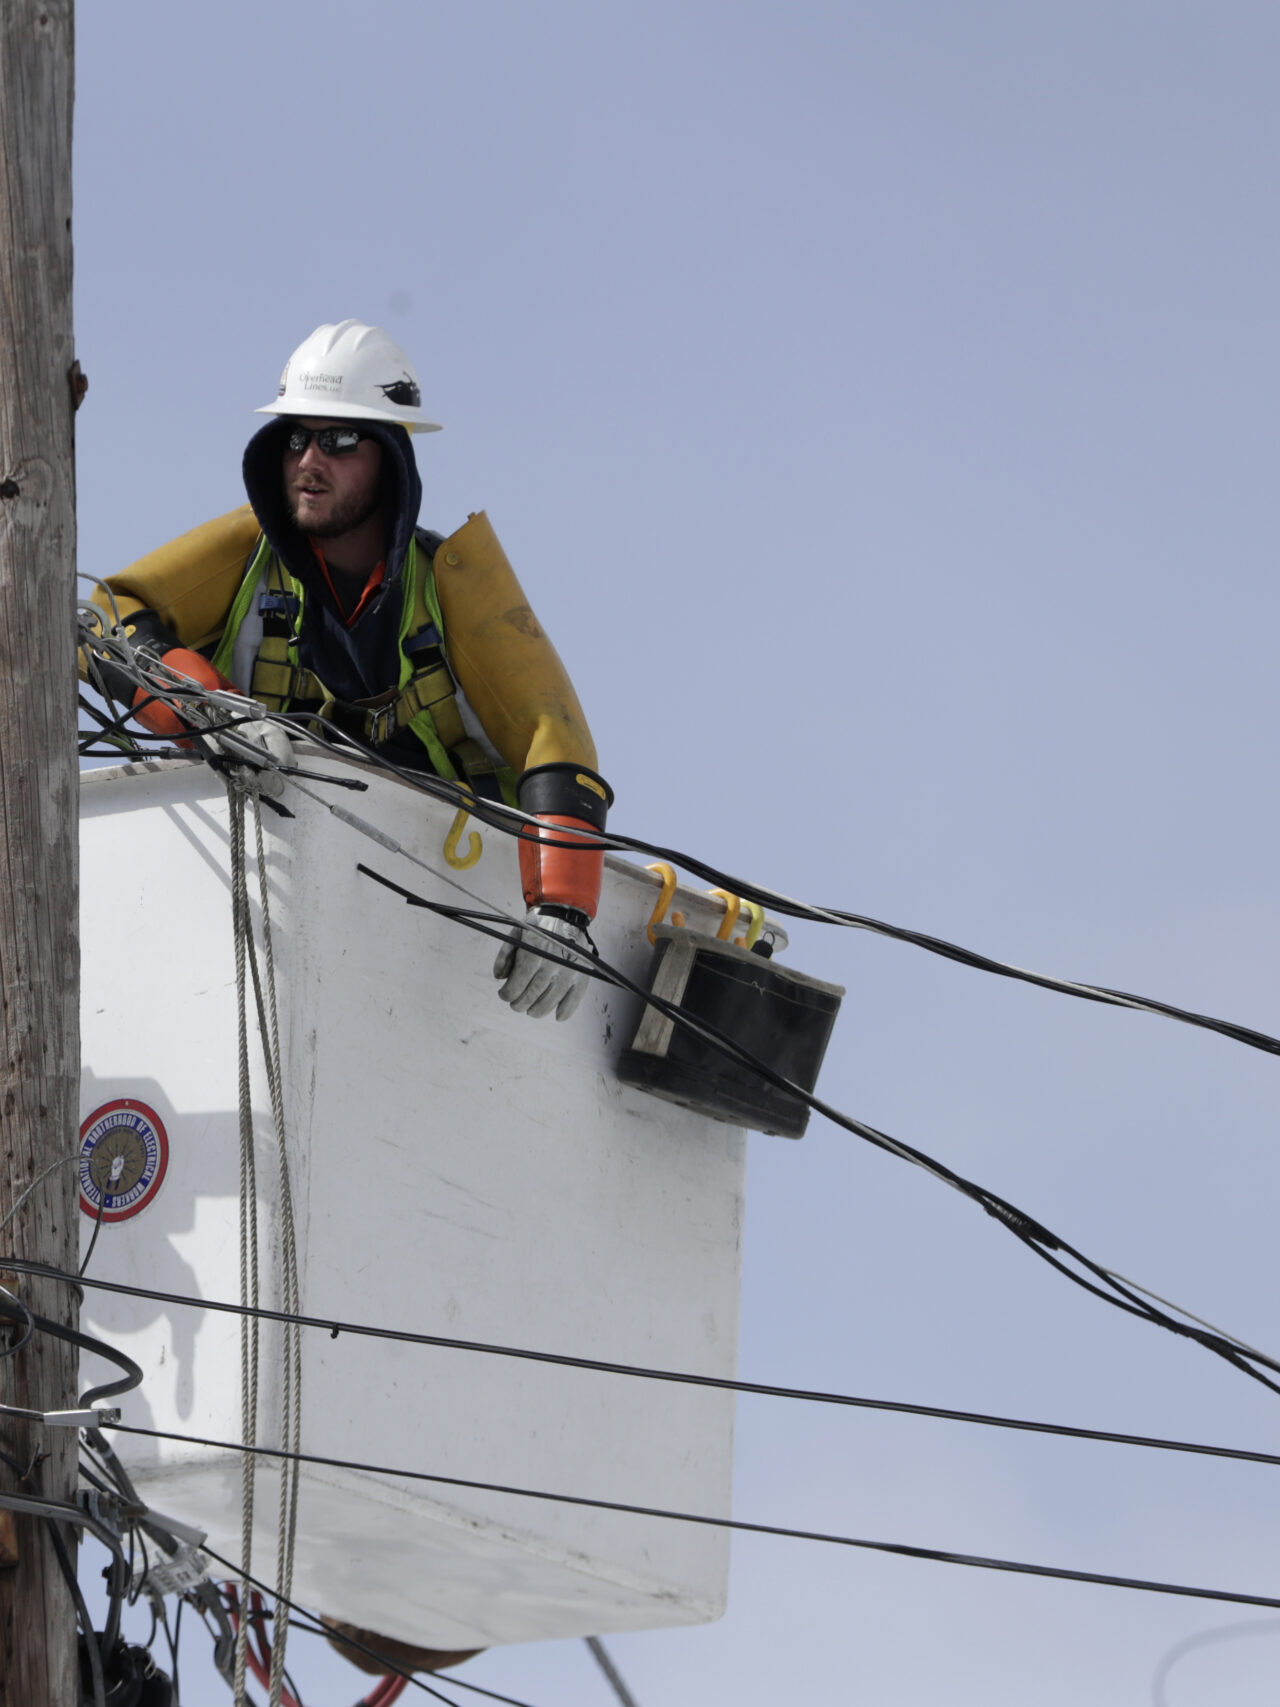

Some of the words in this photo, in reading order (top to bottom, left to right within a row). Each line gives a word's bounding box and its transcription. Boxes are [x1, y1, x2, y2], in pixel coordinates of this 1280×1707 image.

[88, 1114, 137, 1144] BROTHERHOOD
[136, 1120, 148, 1133] OF
[142, 1131, 157, 1181] ELECTRICAL
[112, 1182, 145, 1208] WORKERS
